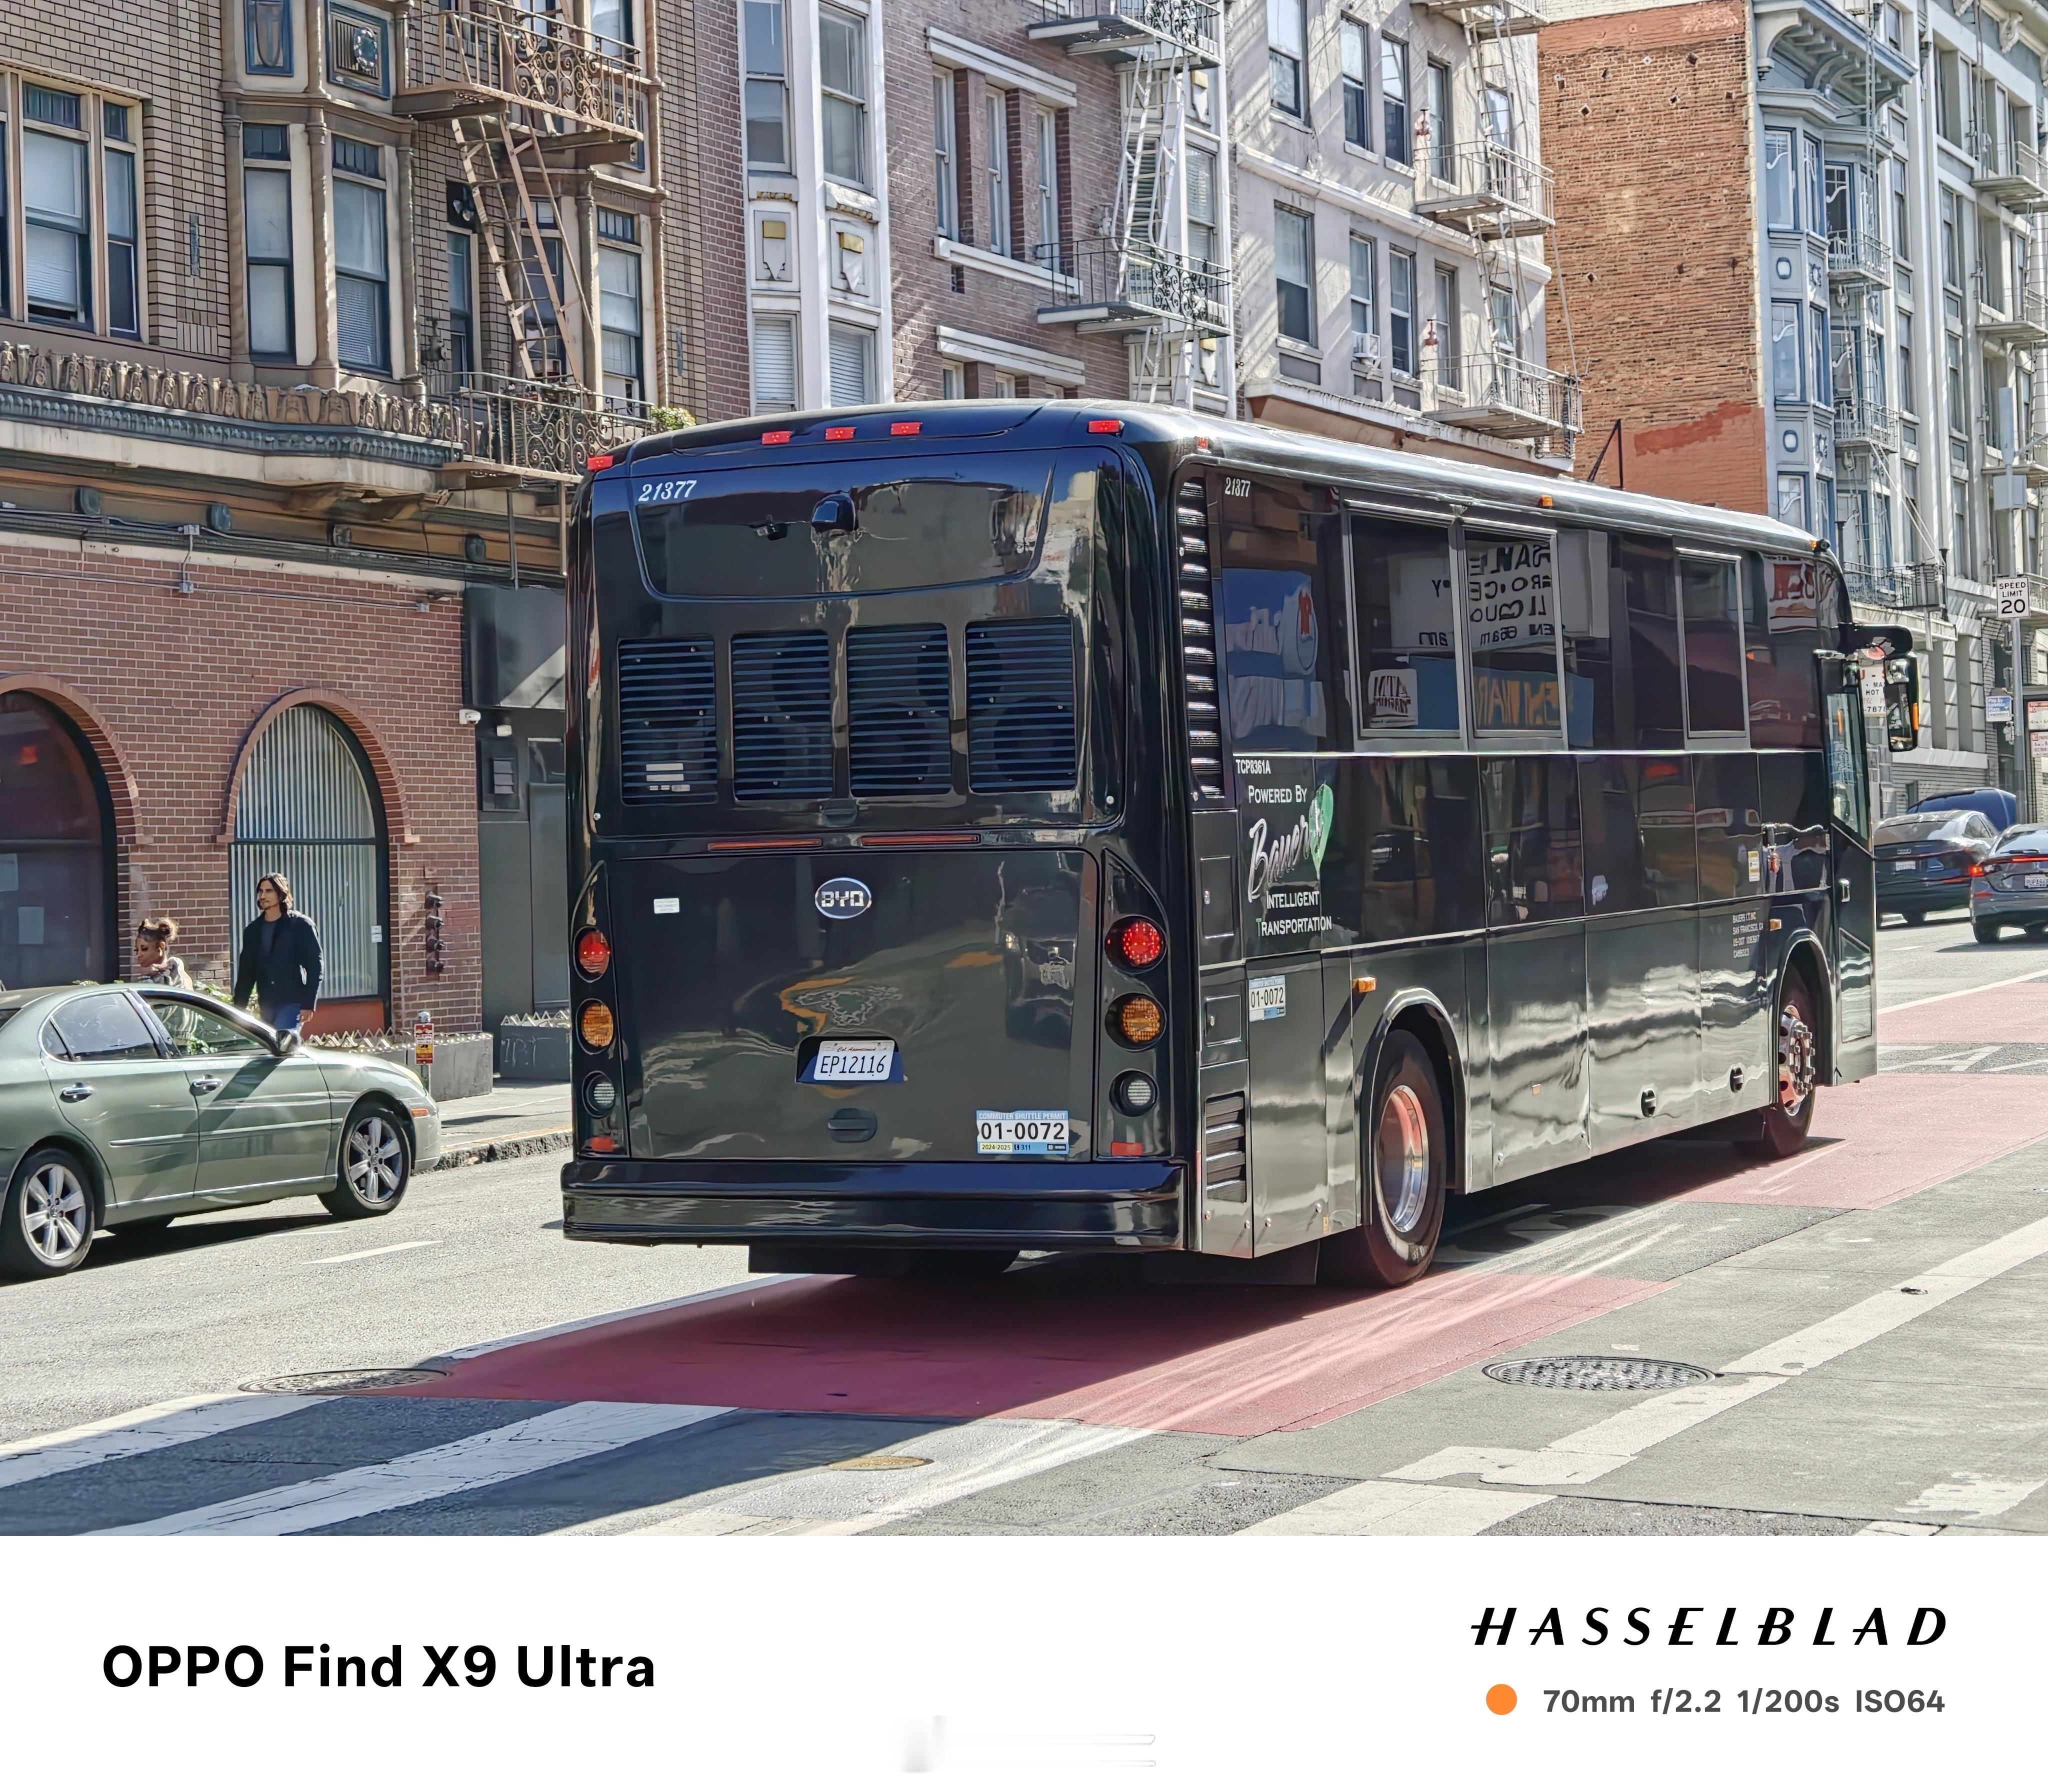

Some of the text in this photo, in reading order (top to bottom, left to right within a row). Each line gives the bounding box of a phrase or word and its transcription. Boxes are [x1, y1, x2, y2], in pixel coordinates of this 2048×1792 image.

[638, 480, 697, 502] 21377
[1224, 476, 1251, 498] 21377
[2001, 598, 2026, 614] 20
[1236, 759, 1271, 774] TCP8361A
[821, 890, 864, 908] BYD
[1250, 987, 1284, 1008] 01-0072
[820, 1055, 887, 1074] EP12116
[981, 1122, 1064, 1140] 01-0072
